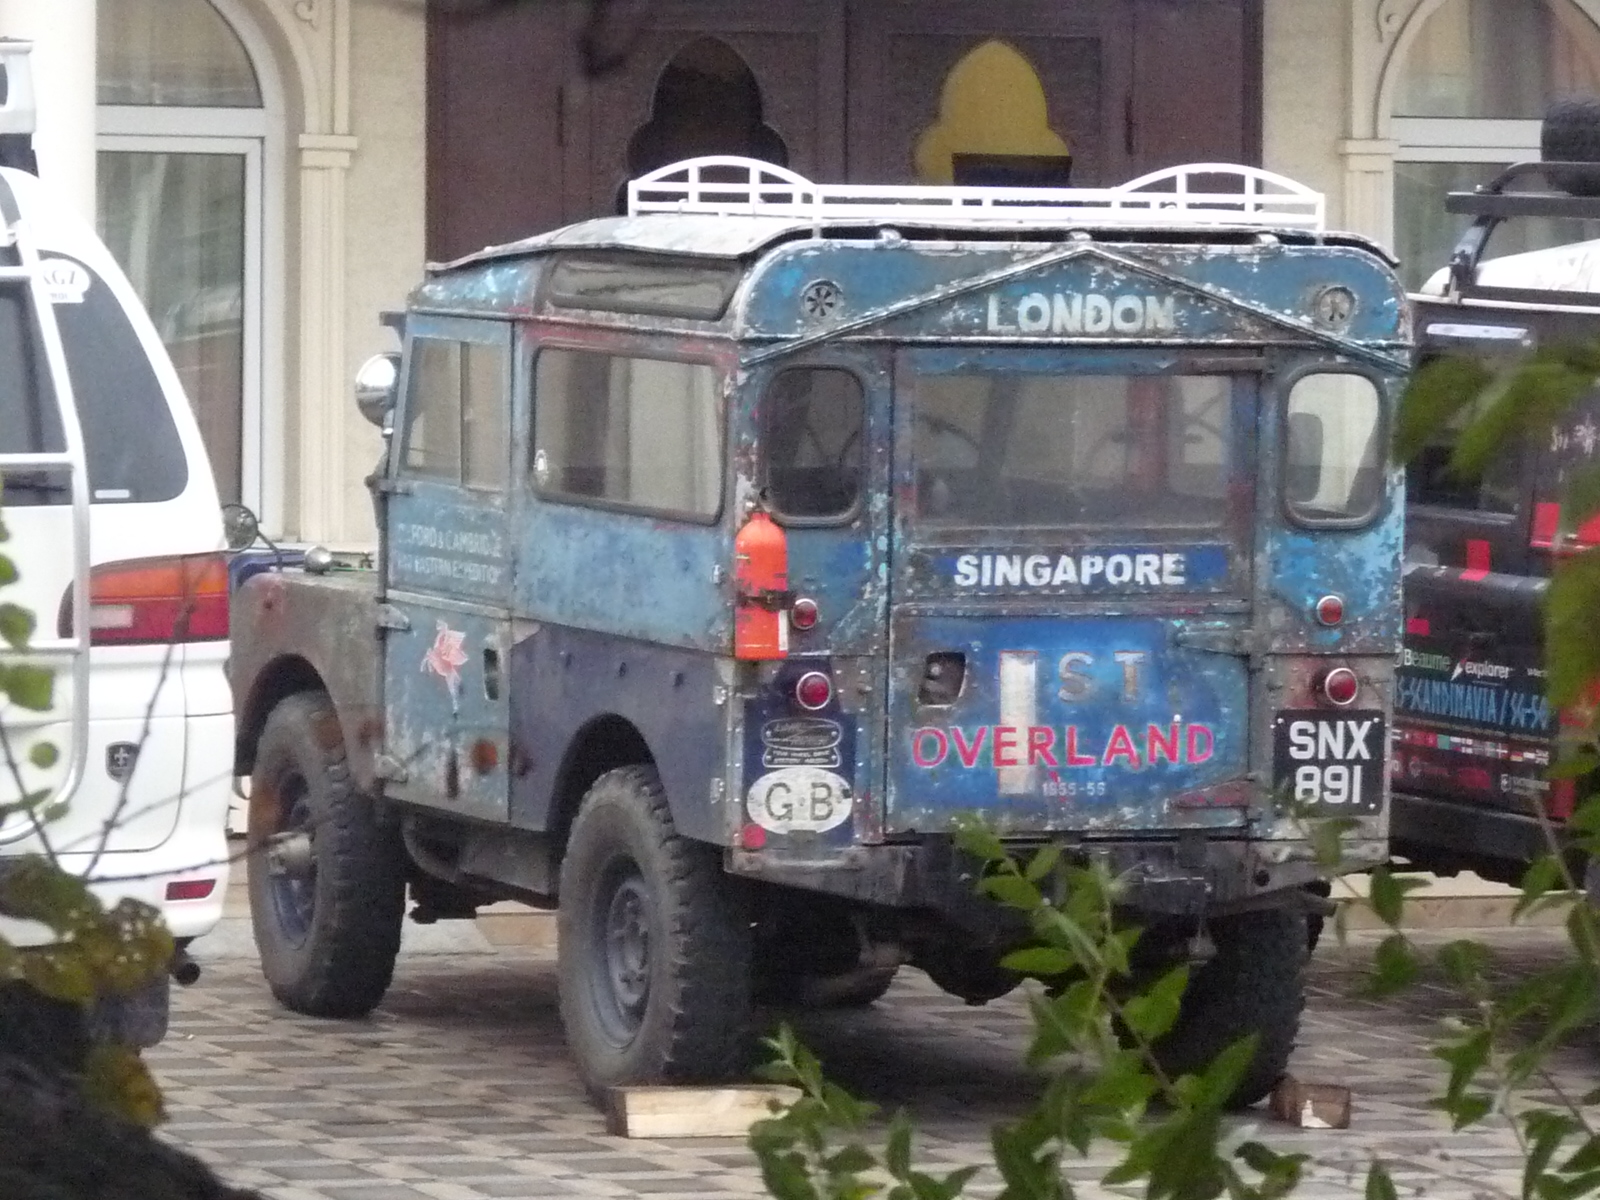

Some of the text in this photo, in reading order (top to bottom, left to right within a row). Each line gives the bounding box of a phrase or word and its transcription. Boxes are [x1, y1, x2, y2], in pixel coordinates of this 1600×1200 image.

[986, 292, 1175, 335] LONDON
[954, 553, 1187, 586] SINGAPORE
[912, 722, 1214, 768] OVERLAND
[1289, 720, 1372, 760] SNX
[1295, 765, 1363, 804] 891
